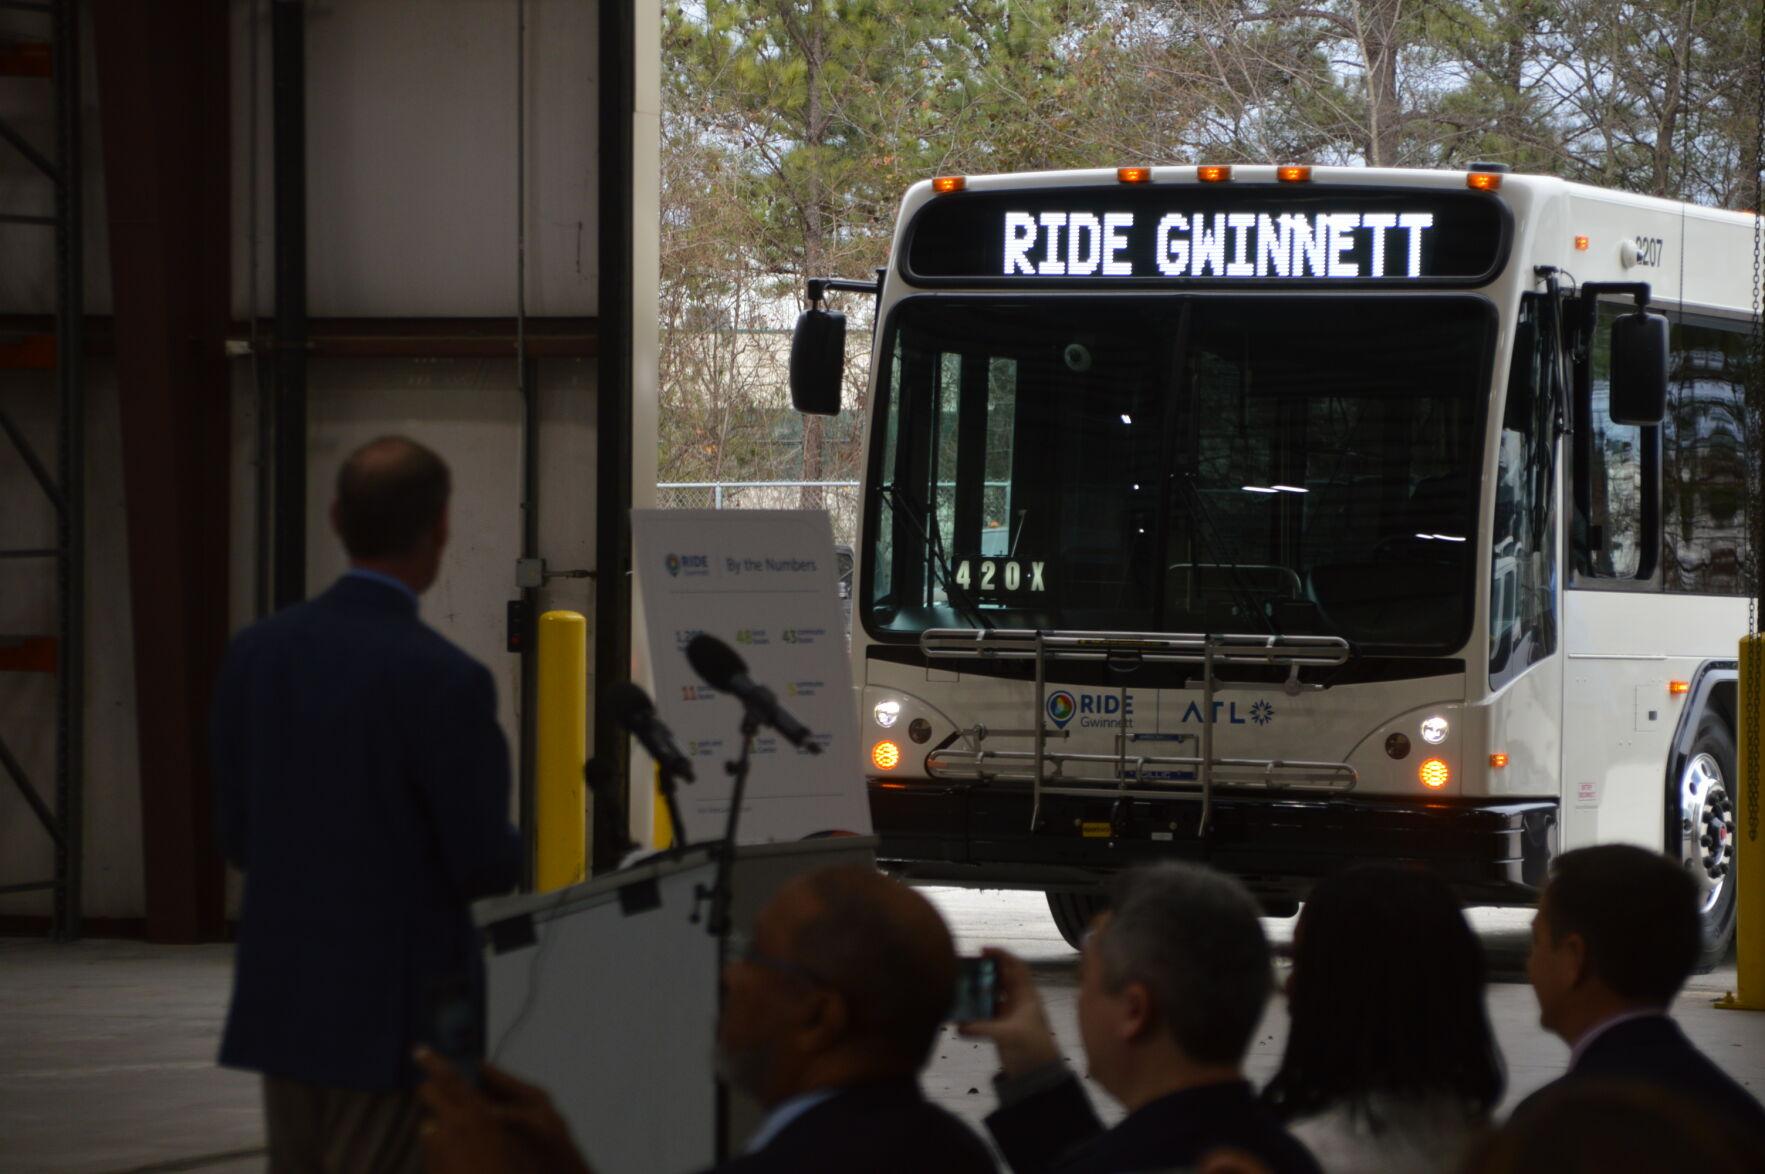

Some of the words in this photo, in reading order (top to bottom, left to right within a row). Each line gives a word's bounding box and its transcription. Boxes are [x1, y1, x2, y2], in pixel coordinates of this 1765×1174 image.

[1003, 212, 1134, 276] RIDE
[1156, 212, 1434, 277] GWINNETT
[726, 557, 741, 574] By
[744, 557, 763, 572] the
[766, 557, 817, 573] Numbers
[1080, 694, 1134, 715] RIDE
[1181, 700, 1246, 724] ATL
